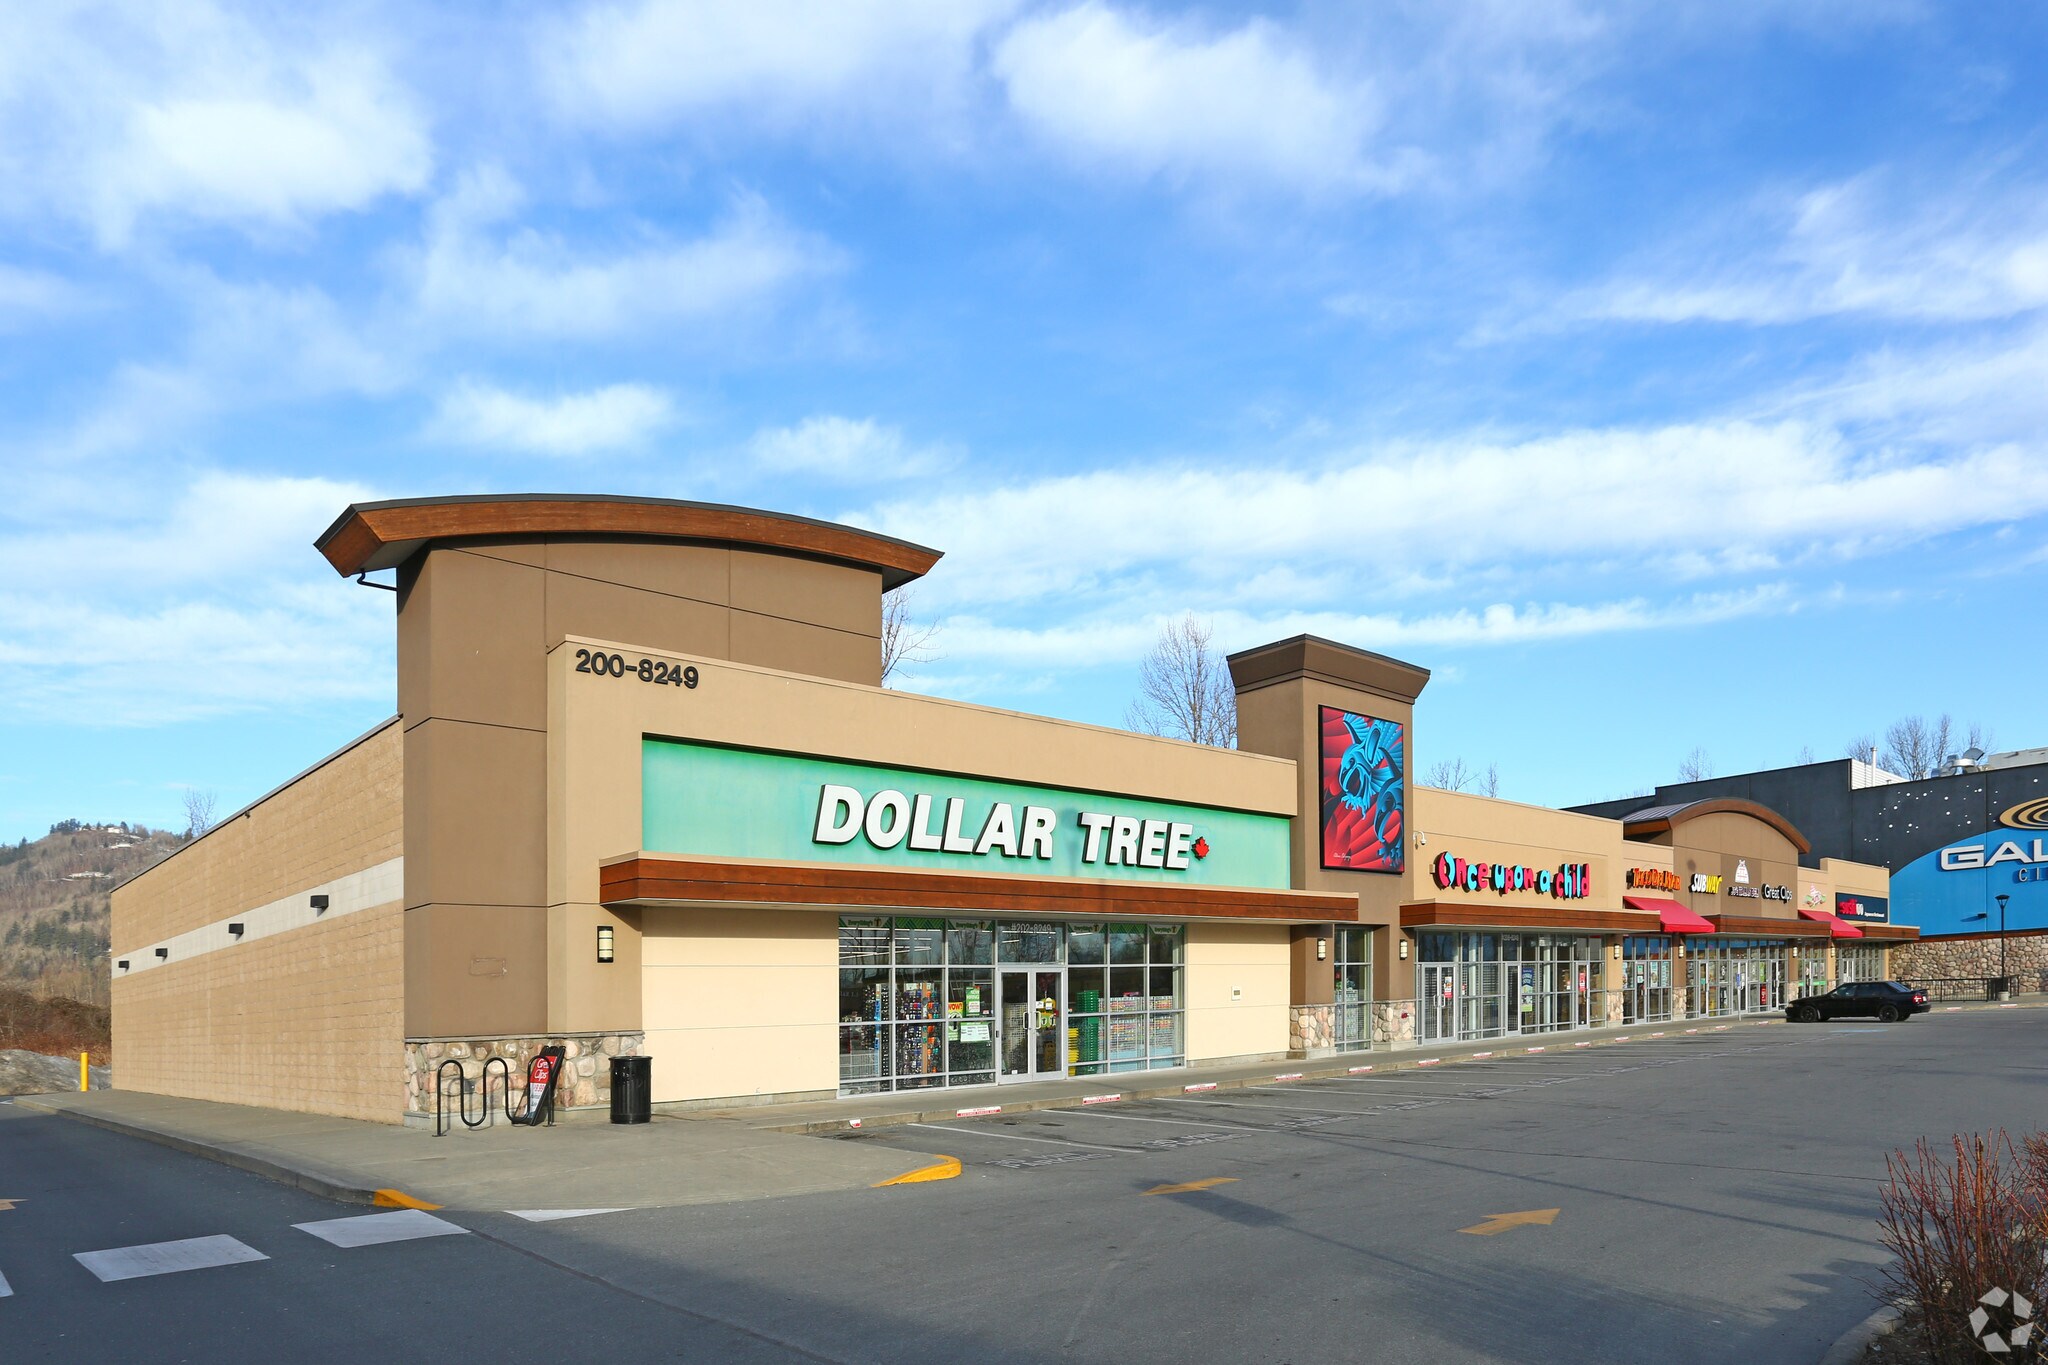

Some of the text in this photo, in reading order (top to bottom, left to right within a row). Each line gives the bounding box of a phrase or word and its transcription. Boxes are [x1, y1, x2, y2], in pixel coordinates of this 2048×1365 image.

[575, 648, 699, 690] 200-8249
[812, 783, 1195, 871] DOLLAR TREE
[1436, 851, 1590, 898] Once upon a child
[1691, 873, 1722, 894] SUBWAY
